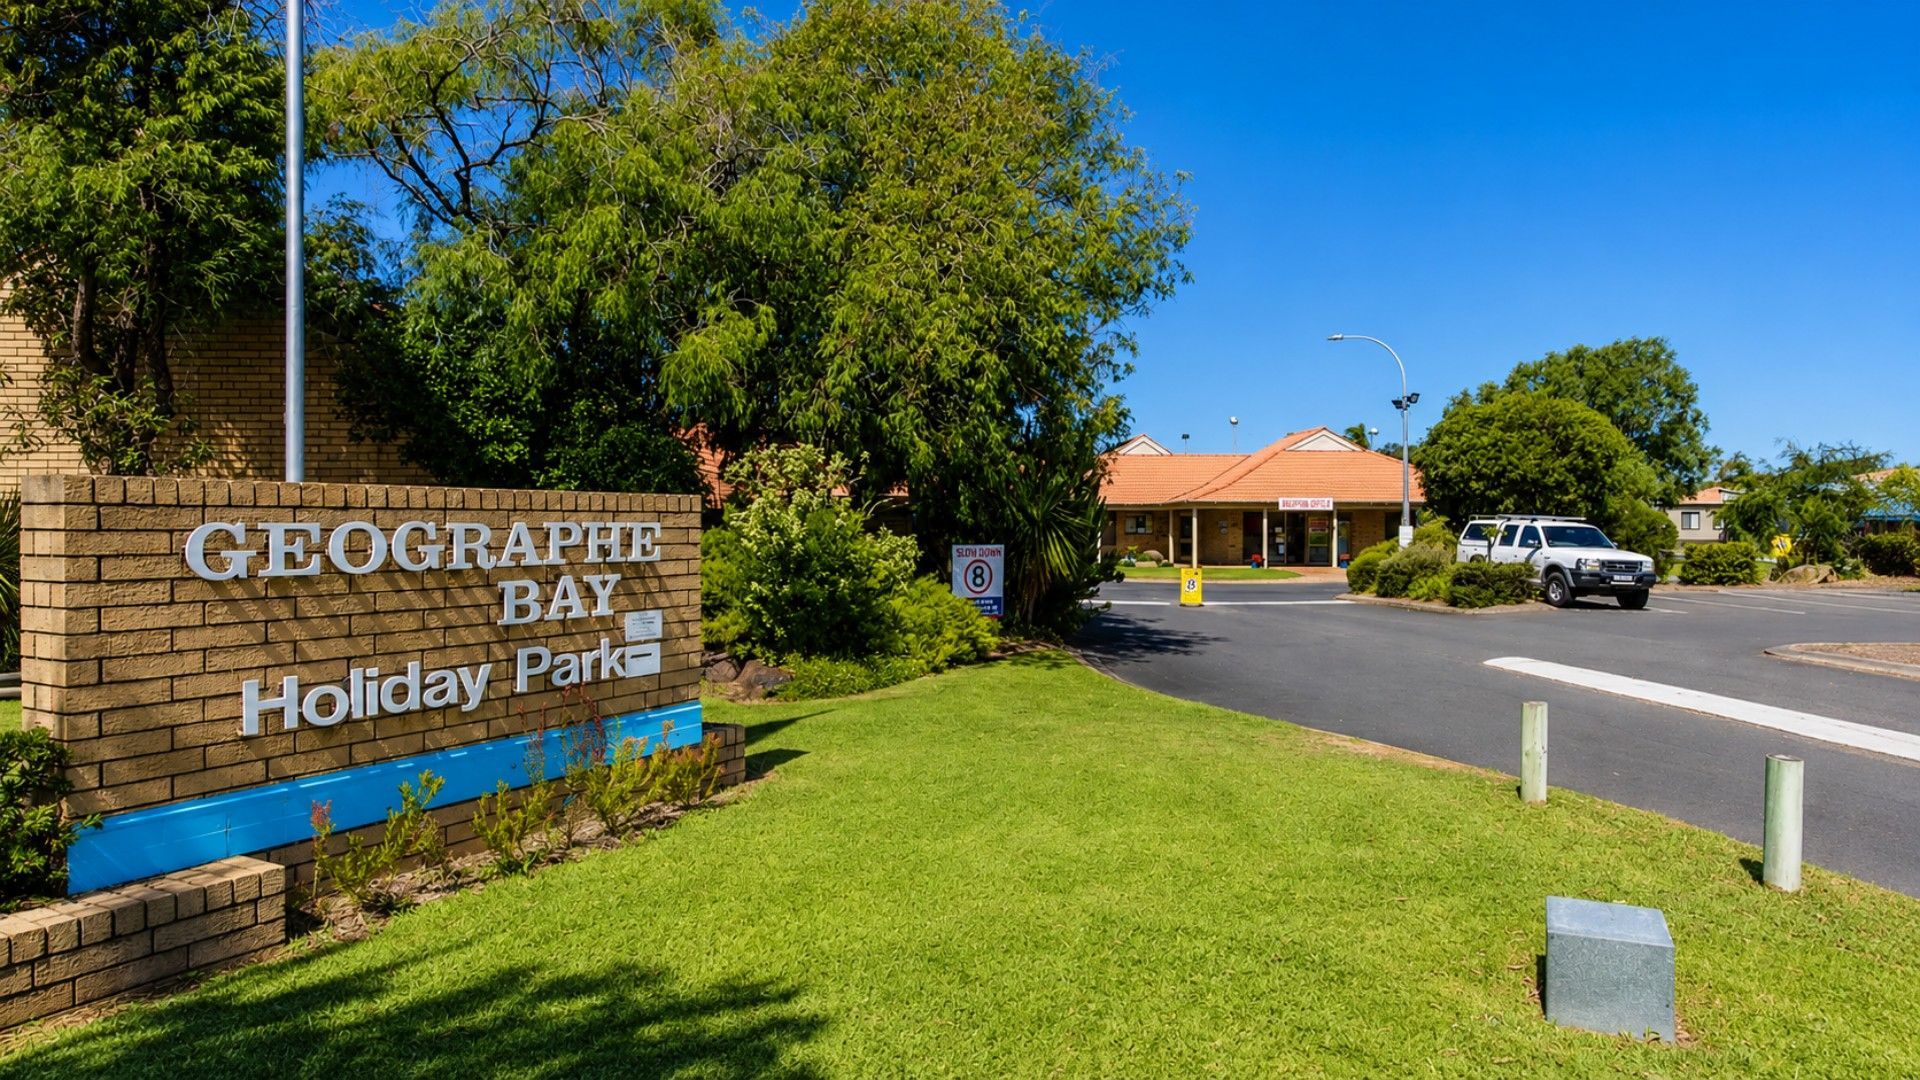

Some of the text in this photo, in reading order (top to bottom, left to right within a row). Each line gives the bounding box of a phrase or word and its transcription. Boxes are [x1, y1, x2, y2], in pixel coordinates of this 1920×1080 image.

[184, 520, 662, 581] GEOGRAPHE
[972, 565, 985, 588] 8
[497, 573, 621, 626] BAY
[514, 637, 627, 693] Park
[242, 661, 493, 736] Holiday
